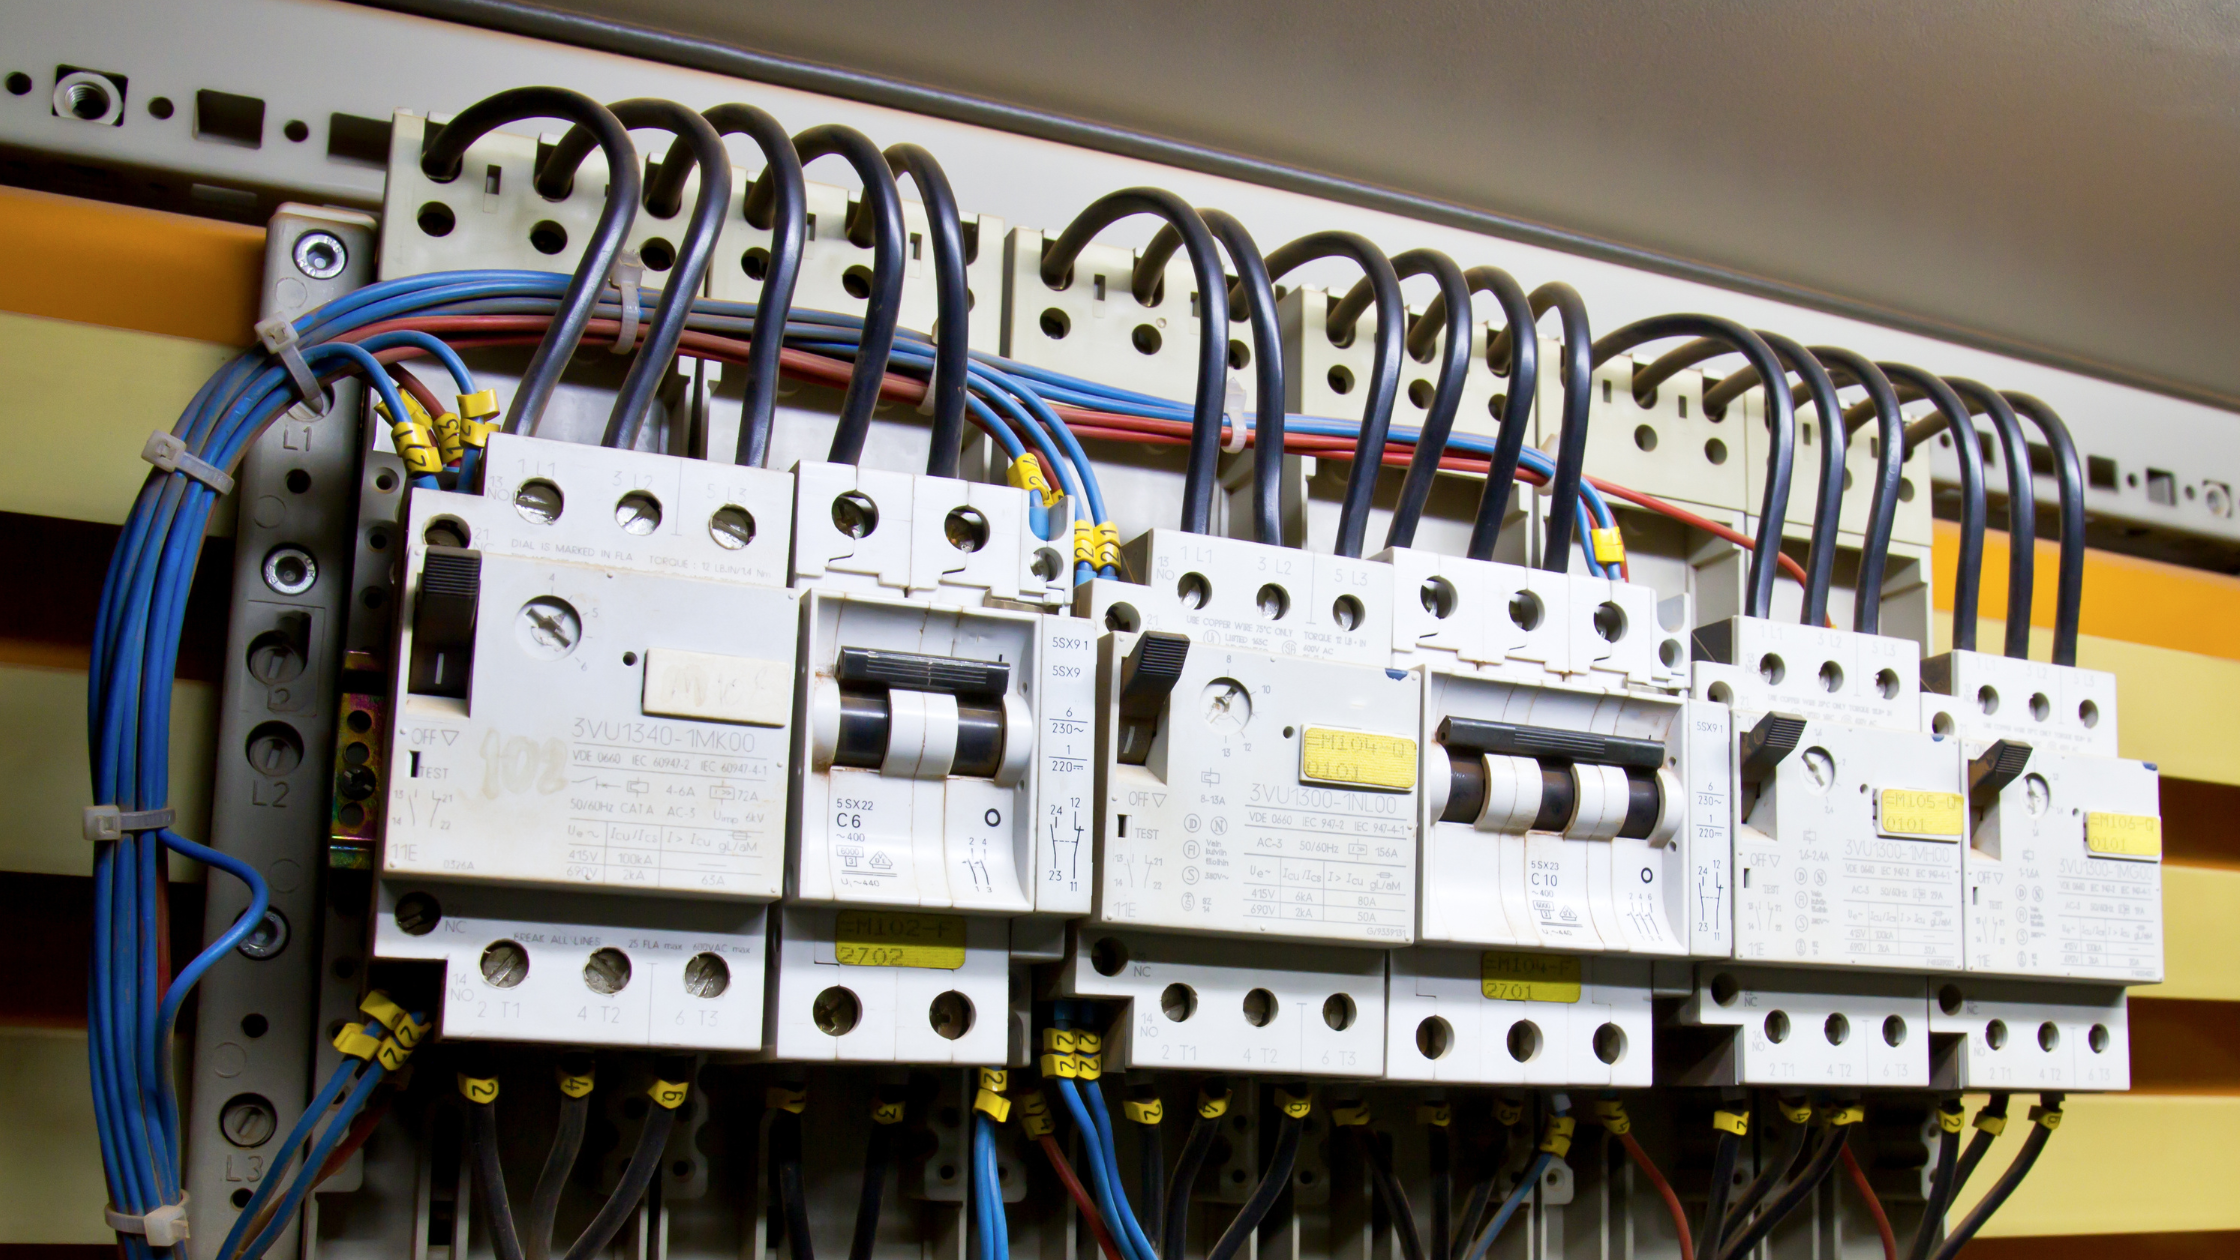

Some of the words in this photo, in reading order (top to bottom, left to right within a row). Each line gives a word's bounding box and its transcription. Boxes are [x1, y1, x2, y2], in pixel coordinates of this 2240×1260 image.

[283, 426, 313, 452] L1
[536, 461, 556, 476] L1
[634, 473, 653, 489] L2
[727, 487, 747, 503] L3
[511, 539, 535, 550] DIAL
[541, 543, 550, 551] IS
[555, 544, 595, 557] MARKED
[601, 550, 611, 558] IN
[615, 551, 633, 561] FLA
[1197, 547, 1213, 563] L1
[649, 555, 689, 569] TORQUE
[1276, 560, 1292, 576] L2
[1352, 570, 1368, 586] L3
[1052, 665, 1081, 678] 5SX9
[411, 727, 437, 745] OFF
[572, 717, 755, 753] 3VU1340-1MK00
[572, 749, 592, 762] VDE
[632, 754, 647, 767] IEC
[701, 761, 716, 772] IEC
[420, 765, 450, 780] TEST
[252, 780, 290, 808] L2
[1128, 791, 1150, 807] OFF
[1250, 782, 1397, 814] 3VU1300-1NL00
[1249, 811, 1267, 823] VDE
[1303, 817, 1317, 828] IEC
[1355, 821, 1369, 832] IEC
[1135, 827, 1159, 840] TEST
[445, 920, 467, 934] NC
[451, 988, 475, 1002] NO
[502, 1002, 521, 1018] T1
[600, 1006, 621, 1024] T2
[698, 1010, 719, 1027] T3
[226, 1154, 264, 1182] L3
